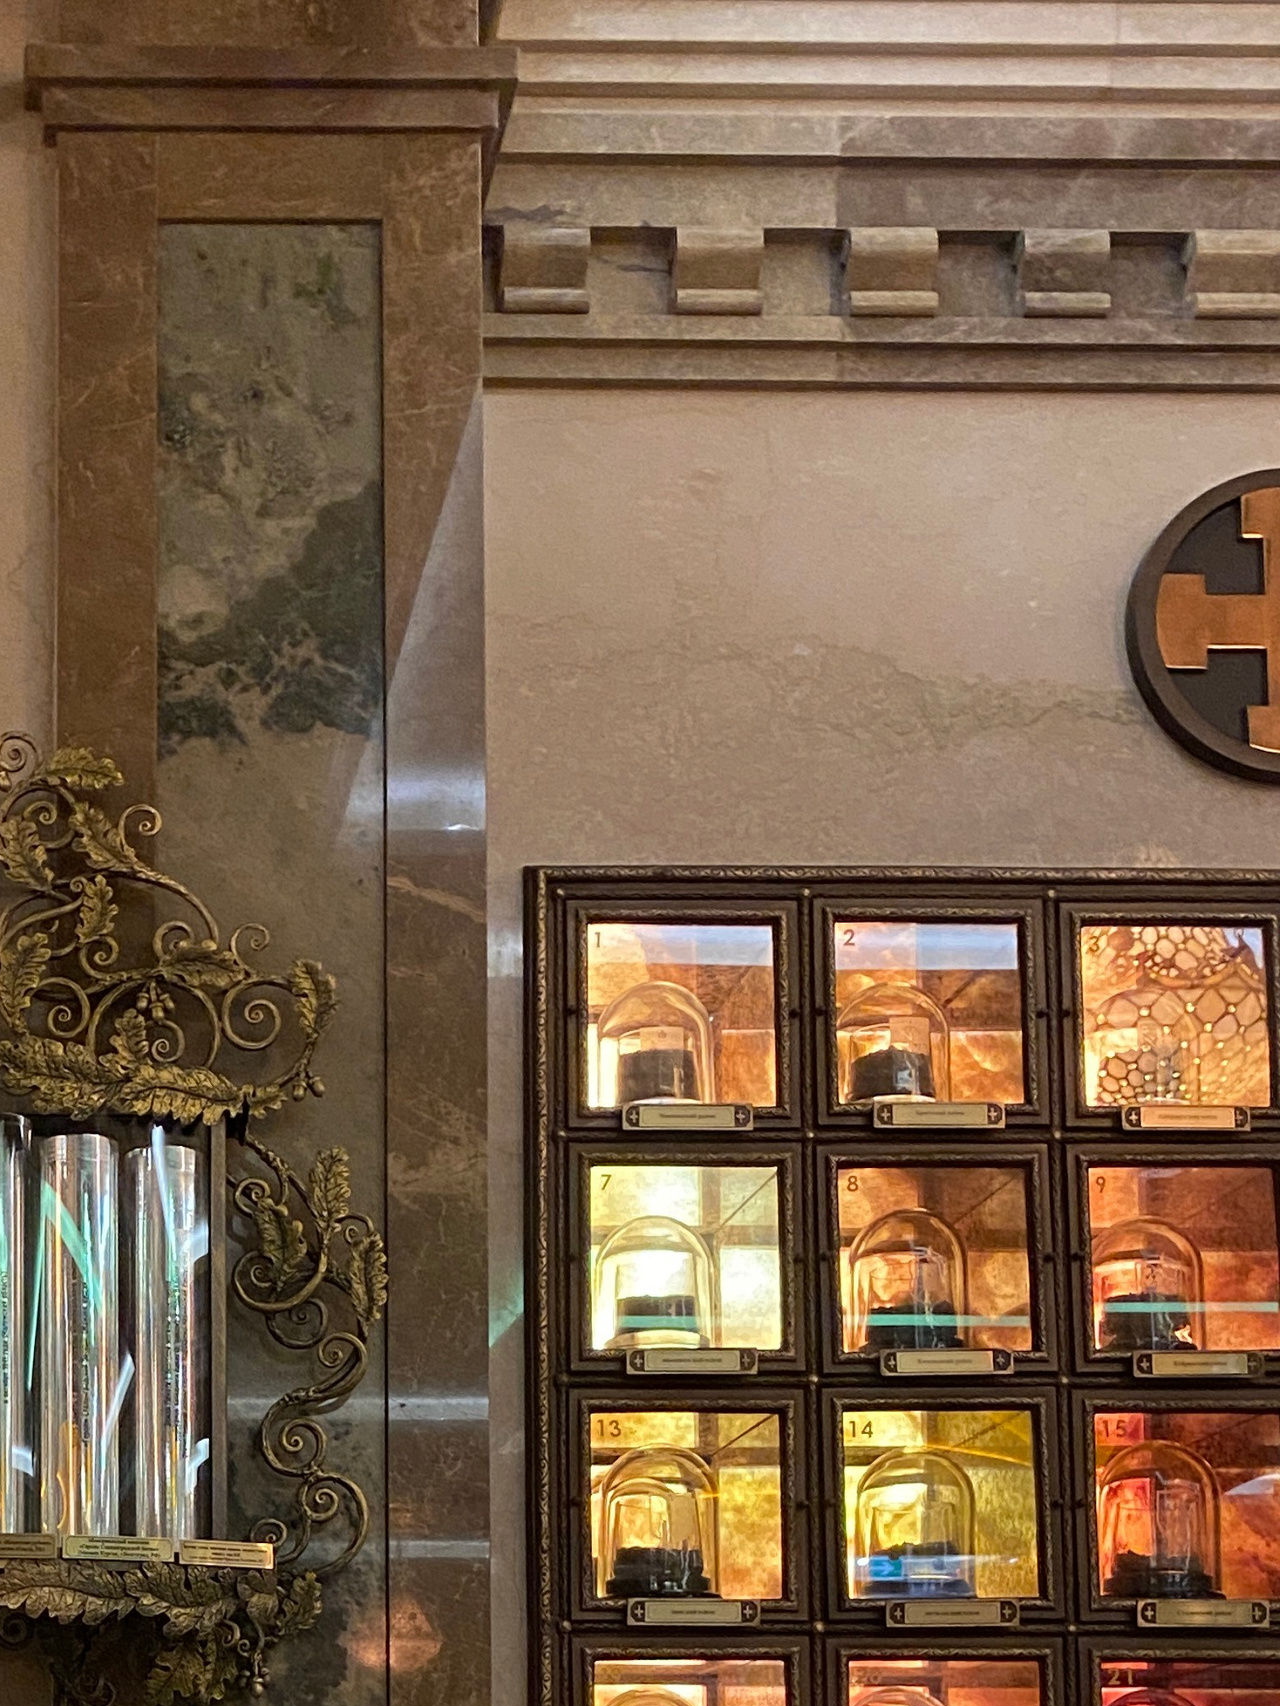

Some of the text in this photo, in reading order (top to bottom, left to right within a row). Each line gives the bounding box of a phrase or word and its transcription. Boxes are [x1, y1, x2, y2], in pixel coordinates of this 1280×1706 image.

[594, 931, 602, 948] 1
[842, 928, 856, 946] 2
[1088, 936, 1102, 953] 3
[599, 1175, 612, 1191] 7
[846, 1175, 859, 1192] 8
[1095, 1176, 1107, 1193] 9
[596, 1420, 621, 1438] 13
[848, 1421, 874, 1439] 14
[1101, 1419, 1125, 1438] 15
[1108, 1669, 1134, 1686] 21
